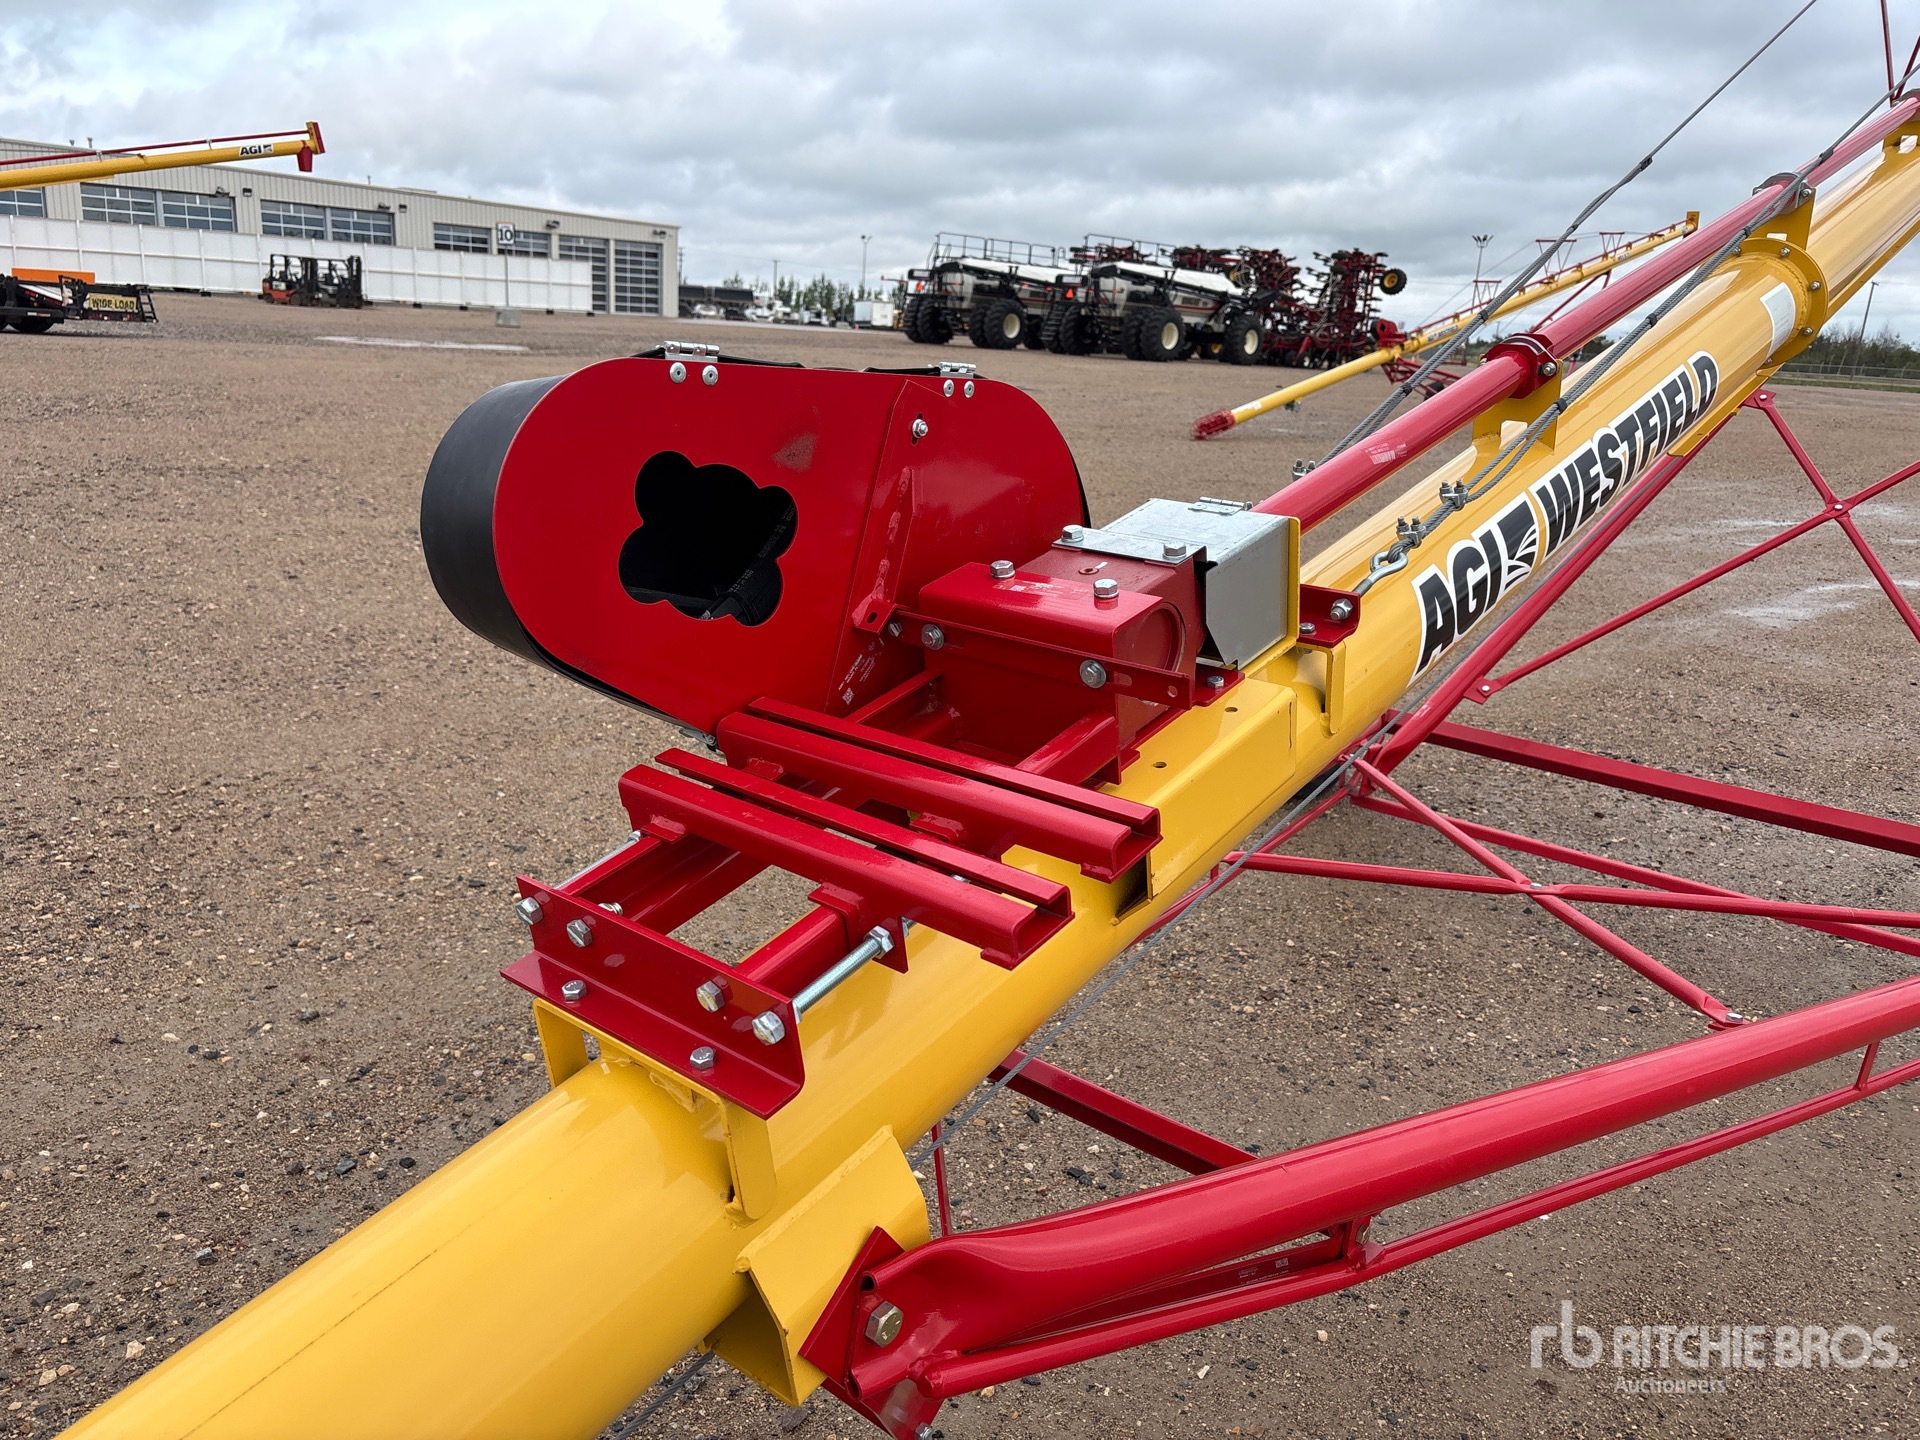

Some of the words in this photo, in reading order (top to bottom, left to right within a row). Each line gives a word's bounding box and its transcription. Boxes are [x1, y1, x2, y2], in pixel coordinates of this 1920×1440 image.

[240, 145, 262, 155] AGI
[499, 229, 513, 241] 10
[115, 300, 135, 310] LOAD
[1416, 525, 1504, 677] AGI
[1534, 354, 1717, 558] WESTFIELD
